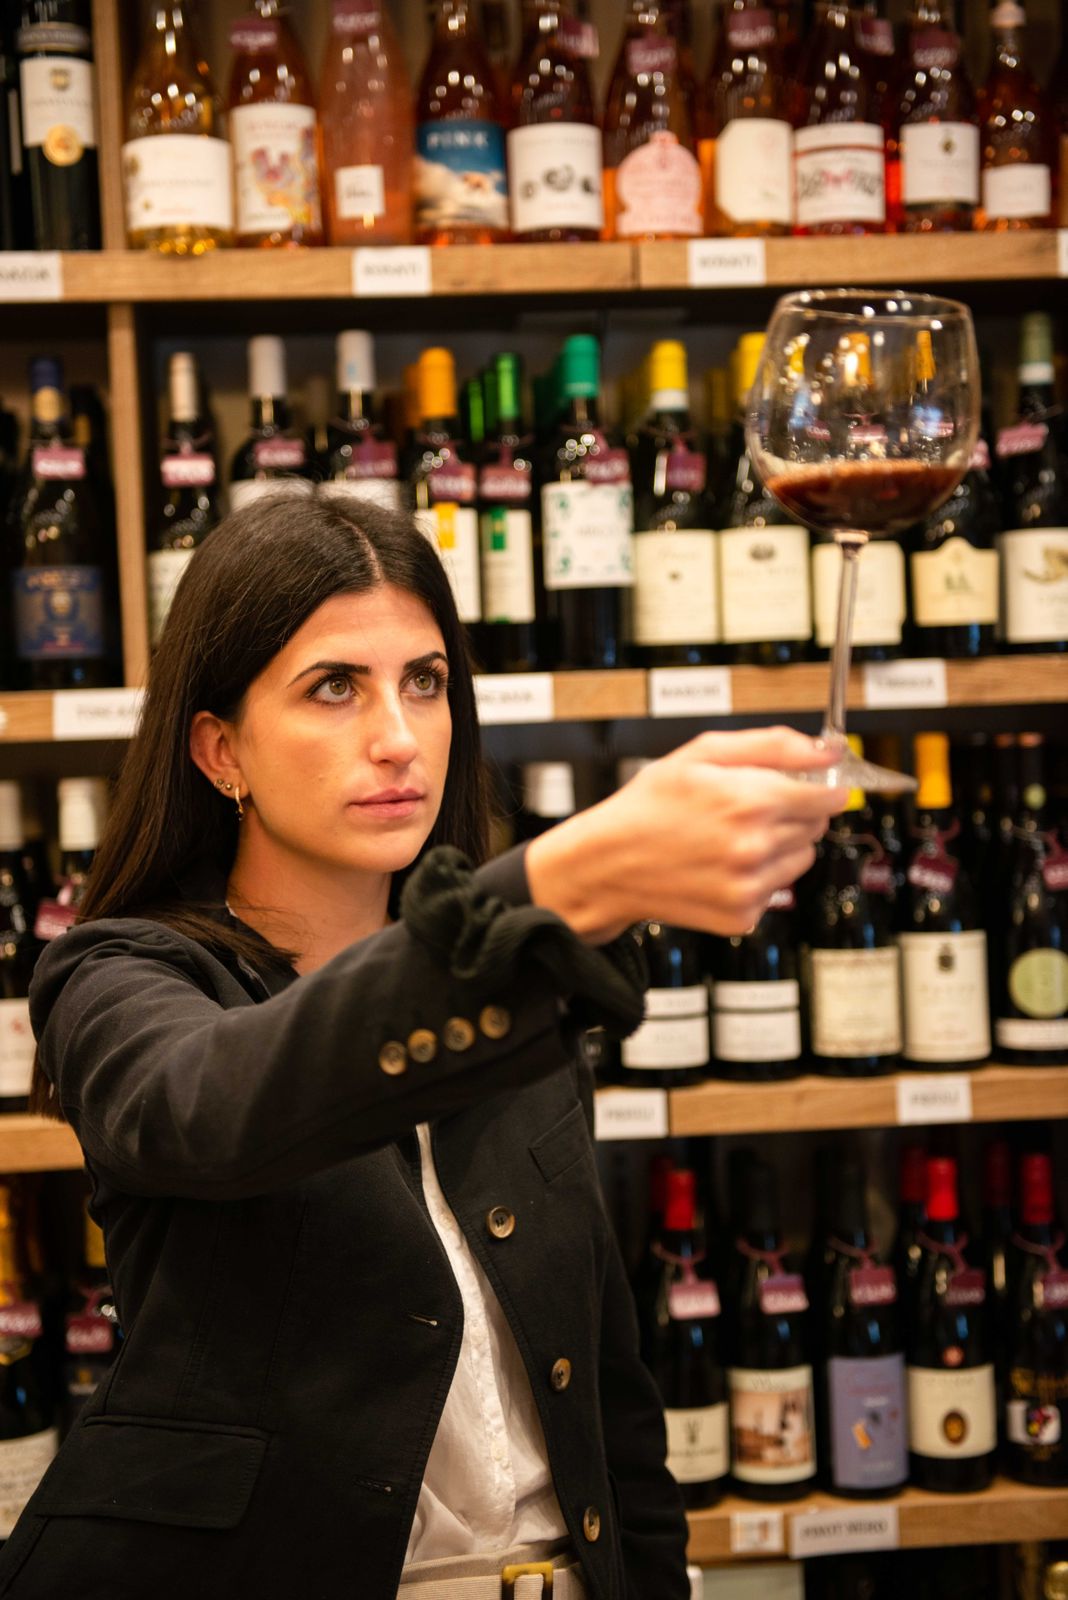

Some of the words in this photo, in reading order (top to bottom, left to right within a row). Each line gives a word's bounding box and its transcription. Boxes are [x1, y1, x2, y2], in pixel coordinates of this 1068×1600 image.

[426, 130, 489, 150] PINK
[801, 1522, 842, 1541] PINOT
[845, 1517, 889, 1537] NERO
